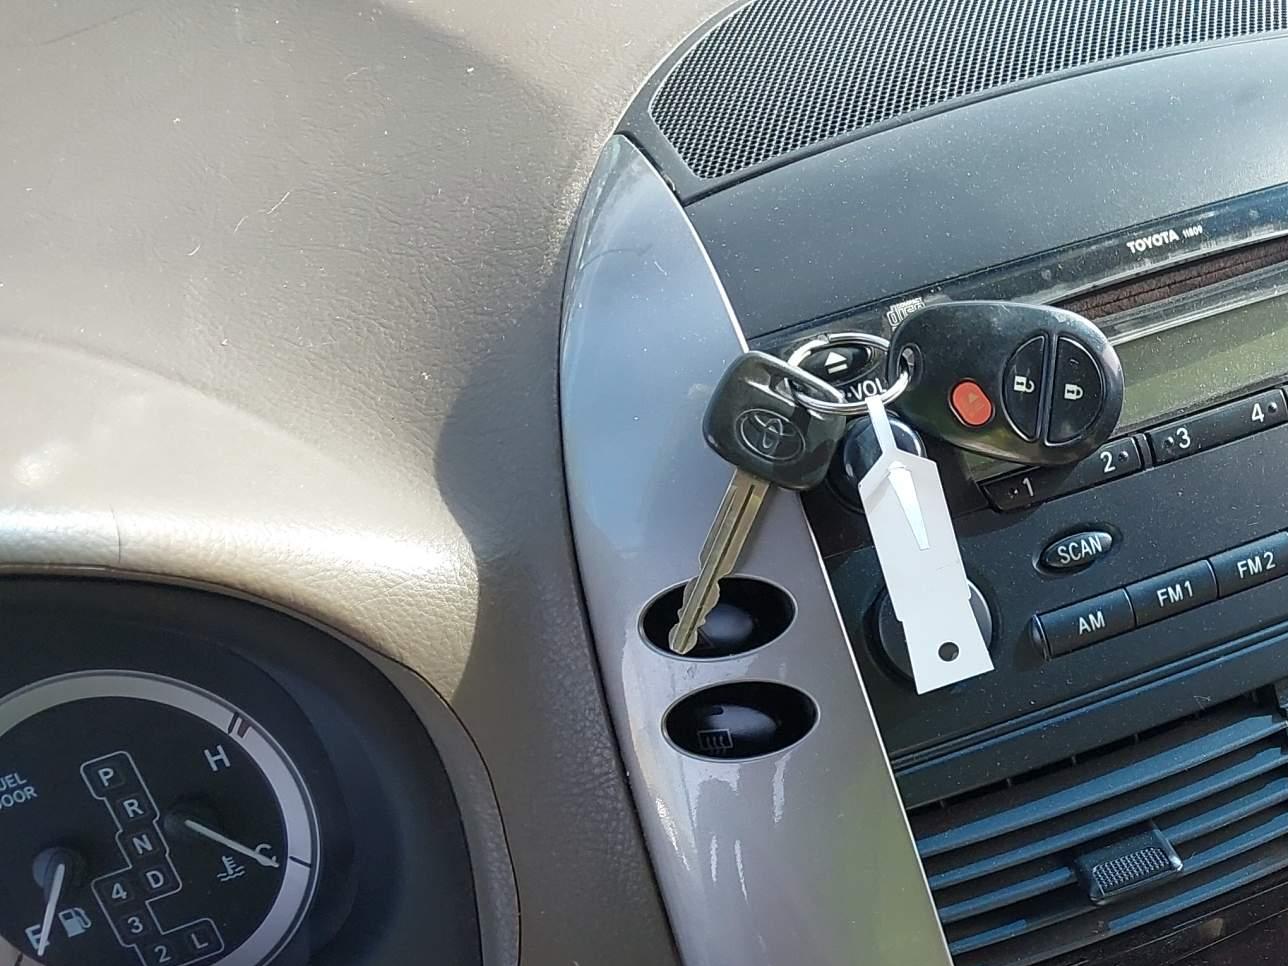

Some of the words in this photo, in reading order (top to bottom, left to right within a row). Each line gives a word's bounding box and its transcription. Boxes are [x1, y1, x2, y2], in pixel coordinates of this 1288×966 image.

[1126, 229, 1180, 254] TOYOTA
[1251, 402, 1265, 424] 4
[1176, 427, 1191, 449] 3
[1100, 451, 1116, 473] 2
[1022, 477, 1034, 497] 1
[1057, 535, 1103, 565] SCAN
[1078, 610, 1106, 635] AM
[204, 745, 231, 771] H
[98, 767, 115, 787] P
[0, 786, 38, 809] OOR
[123, 798, 144, 818] R
[132, 834, 153, 854] N
[111, 882, 128, 900] 4
[147, 870, 165, 889] D
[126, 916, 144, 934] 3
[153, 945, 171, 962] 2
[191, 932, 208, 949] L
